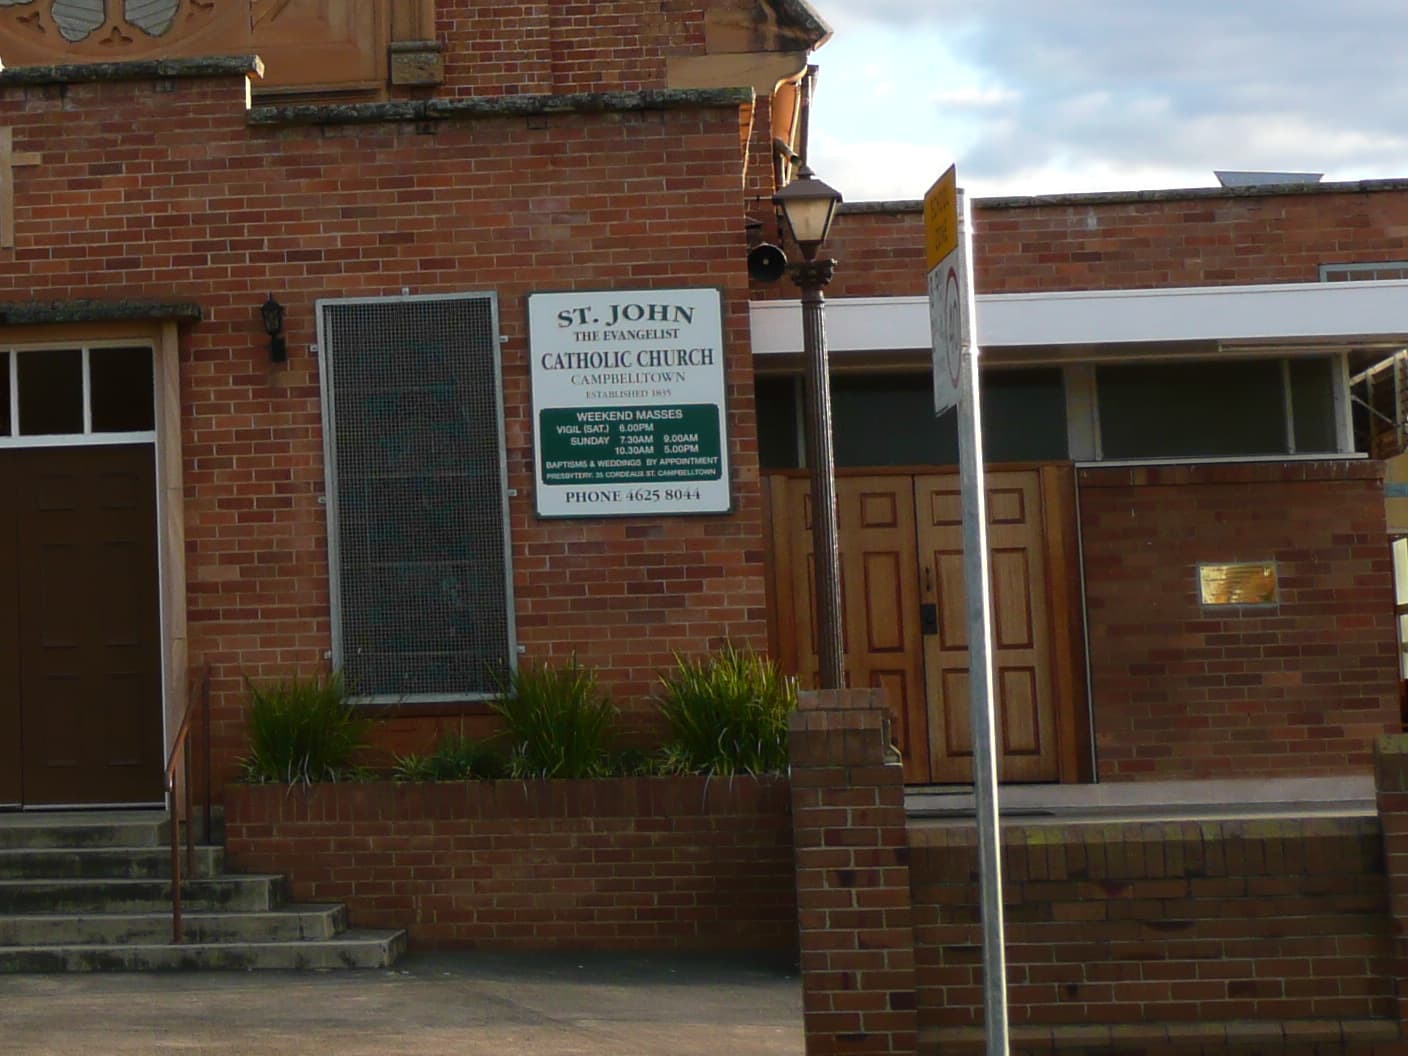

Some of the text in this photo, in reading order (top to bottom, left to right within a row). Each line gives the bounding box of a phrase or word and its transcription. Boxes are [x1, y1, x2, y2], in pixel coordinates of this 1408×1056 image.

[557, 304, 695, 328] ST. JOHN
[574, 328, 680, 342] THE EVANGELIST
[541, 348, 714, 370] CATHOLIC CHURCH
[571, 372, 686, 385] CAMPBELLTOWN
[586, 390, 648, 399] ESTABLISHED
[576, 409, 683, 422] WEEKEND MASSES
[556, 425, 581, 434] VIGIL
[570, 433, 698, 445] SUNDAY 7.30AM 9.00AM
[615, 446, 654, 455] 10.30AM
[545, 460, 588, 469] BAPTISMS
[597, 459, 641, 467] WEDDINGS
[646, 458, 657, 466] BY
[659, 456, 719, 466] APPOINTMENT
[565, 488, 700, 503] PHONE 4625 8044
